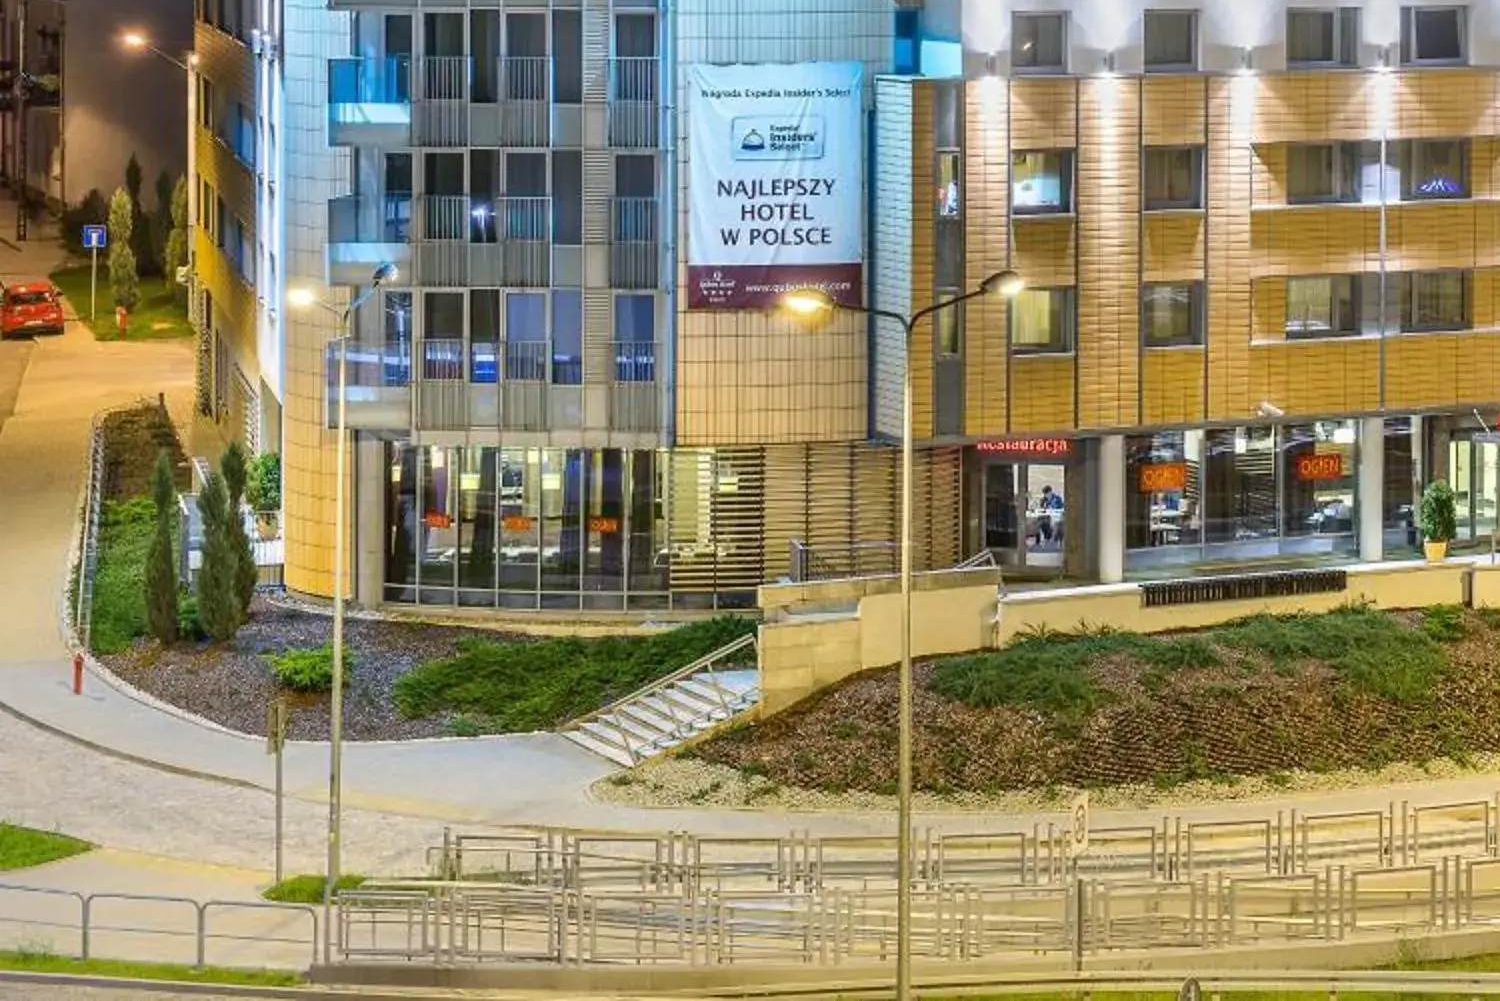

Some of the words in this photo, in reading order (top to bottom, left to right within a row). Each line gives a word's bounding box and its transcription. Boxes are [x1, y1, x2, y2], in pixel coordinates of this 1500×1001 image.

[745, 88, 781, 100] Expedia
[824, 88, 851, 98] Select
[717, 178, 836, 199] NAJLEPSZY
[740, 203, 814, 222] HOTEL
[720, 228, 741, 246] W
[749, 227, 832, 246] POLSCE
